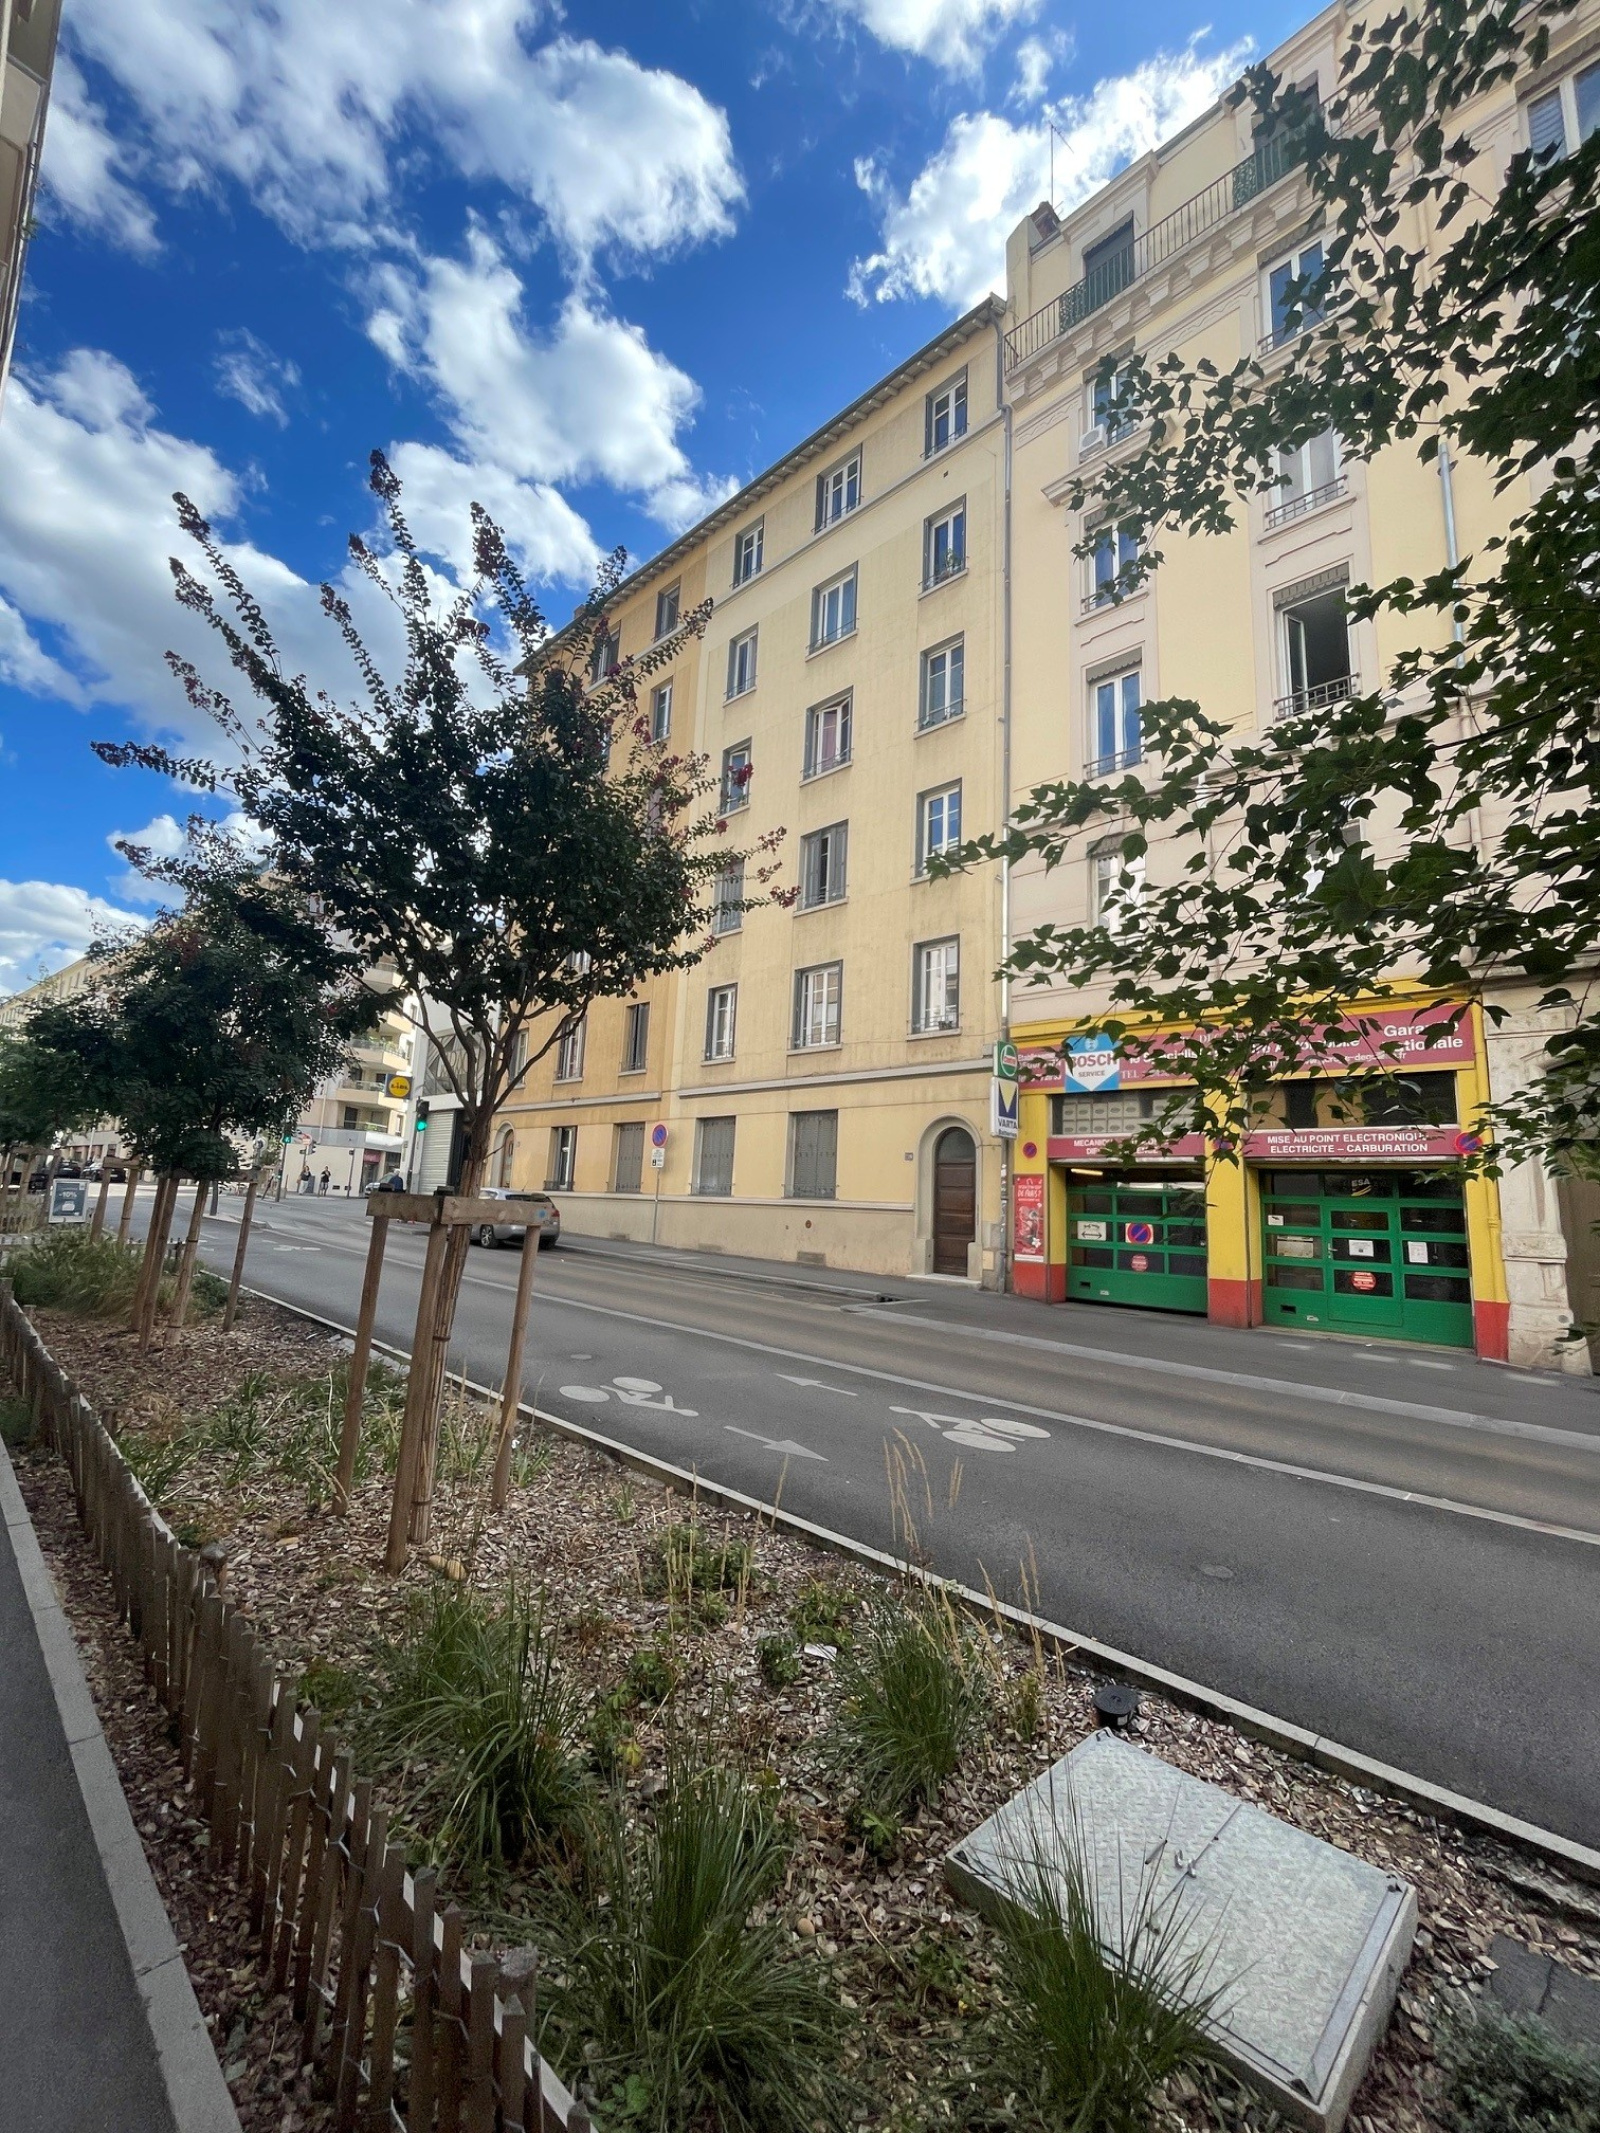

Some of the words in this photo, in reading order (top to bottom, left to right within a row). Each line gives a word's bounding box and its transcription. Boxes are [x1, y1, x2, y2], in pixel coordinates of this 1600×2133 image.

[1078, 1070, 1106, 1078] SERVICE
[998, 1117, 1018, 1129] VARTA
[1267, 1135, 1290, 1144] MISE
[1293, 1134, 1306, 1143] AU
[1309, 1134, 1340, 1143] POINT
[1270, 1145, 1335, 1153] ELECTRICITE
[1346, 1143, 1428, 1152] CARBURATION
